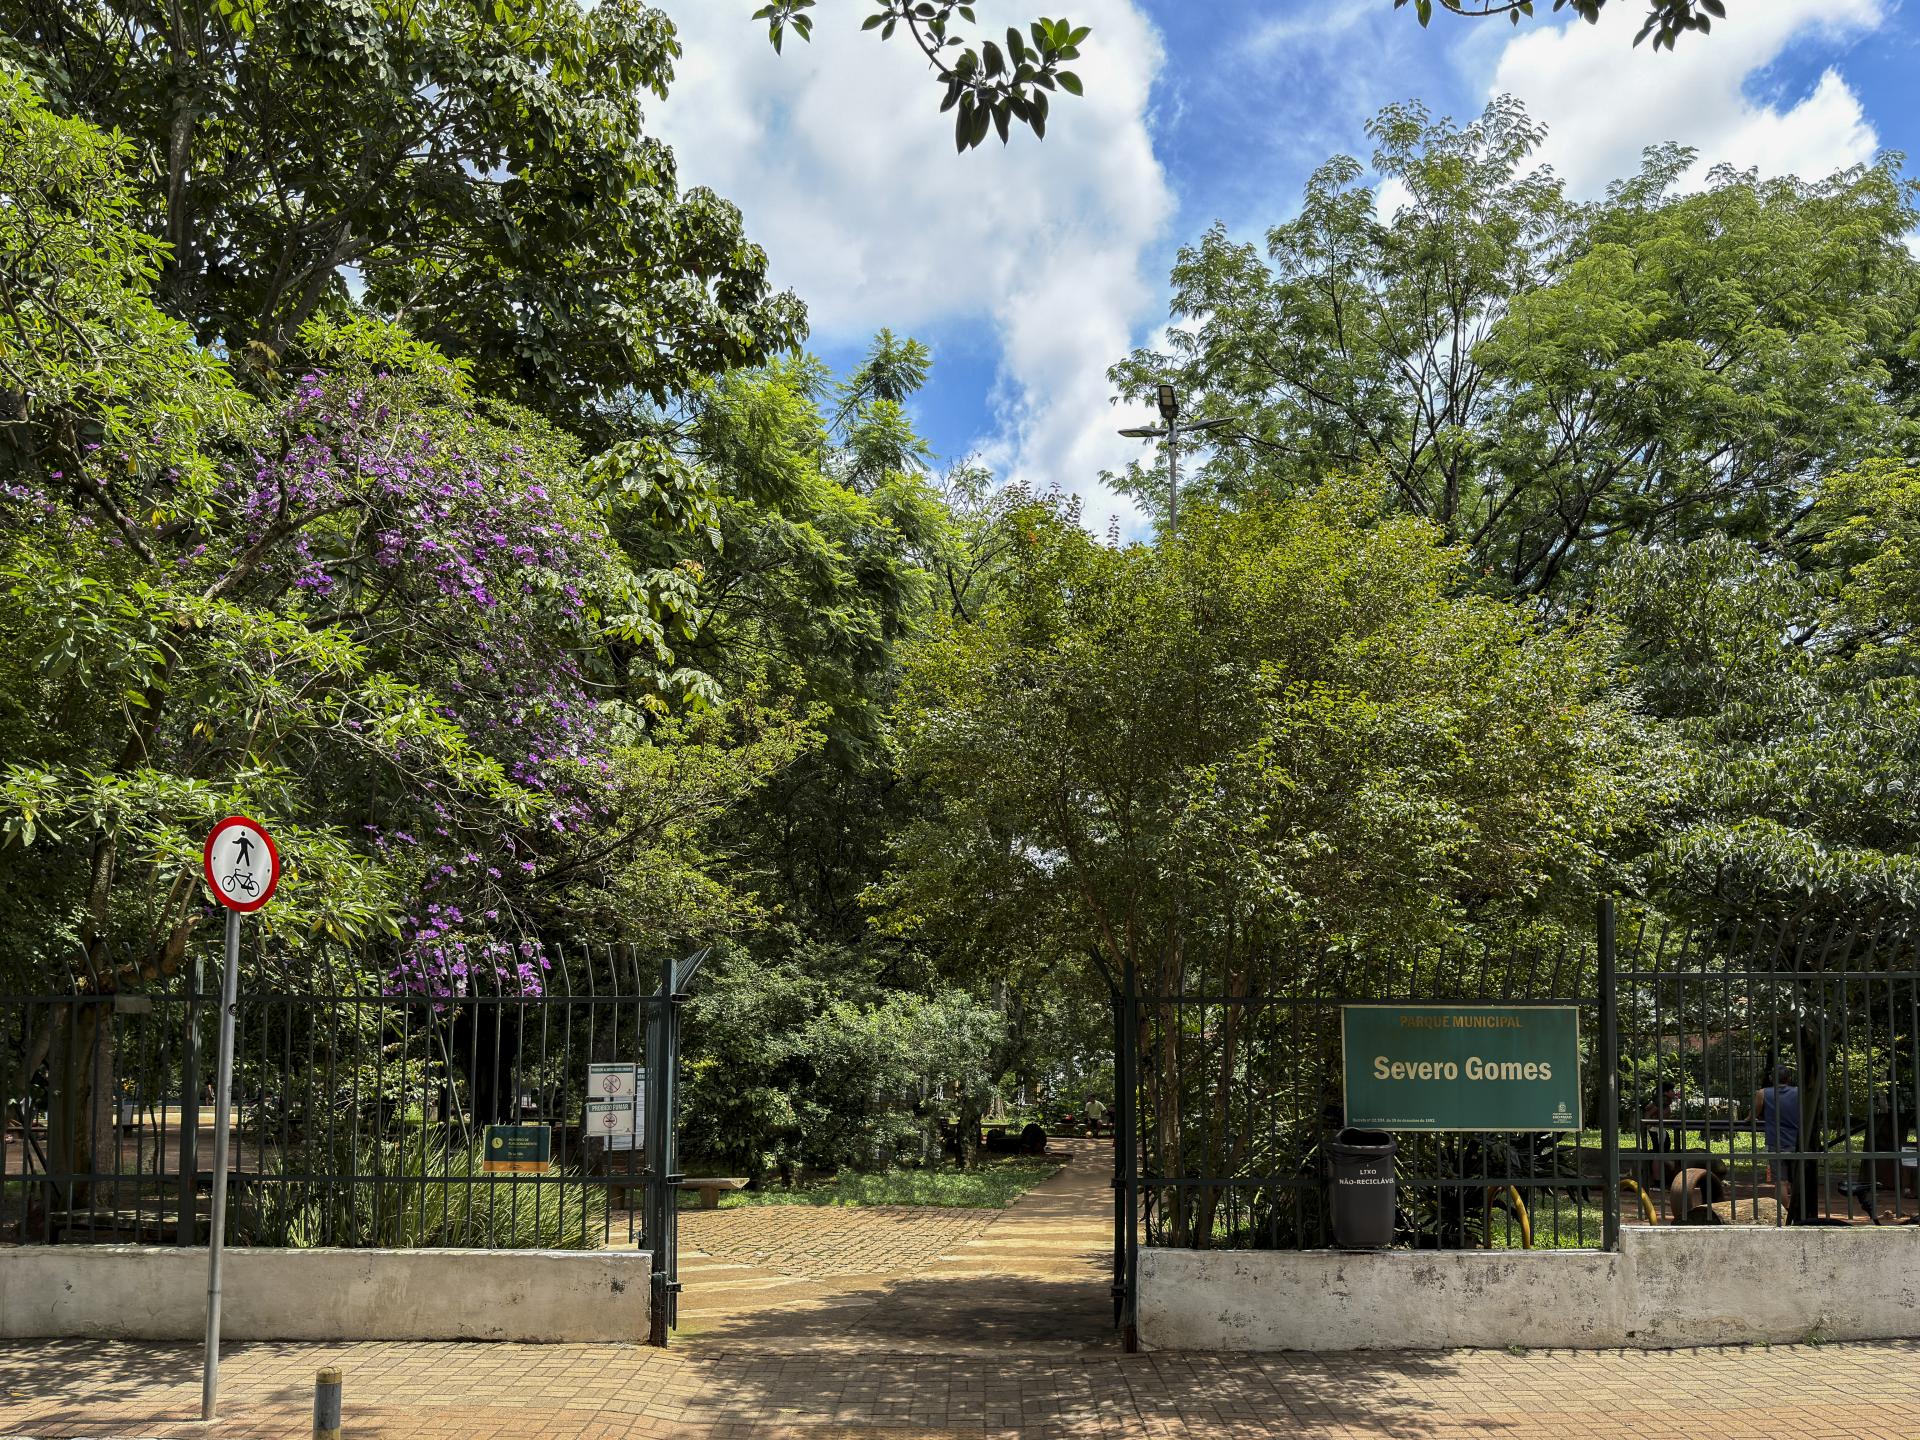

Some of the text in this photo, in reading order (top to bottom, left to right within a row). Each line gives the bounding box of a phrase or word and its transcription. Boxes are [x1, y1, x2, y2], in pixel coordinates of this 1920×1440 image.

[1400, 1016, 1523, 1029] PARQUE MUNICIPAL
[1374, 1056, 1552, 1080] Severo Gomes
